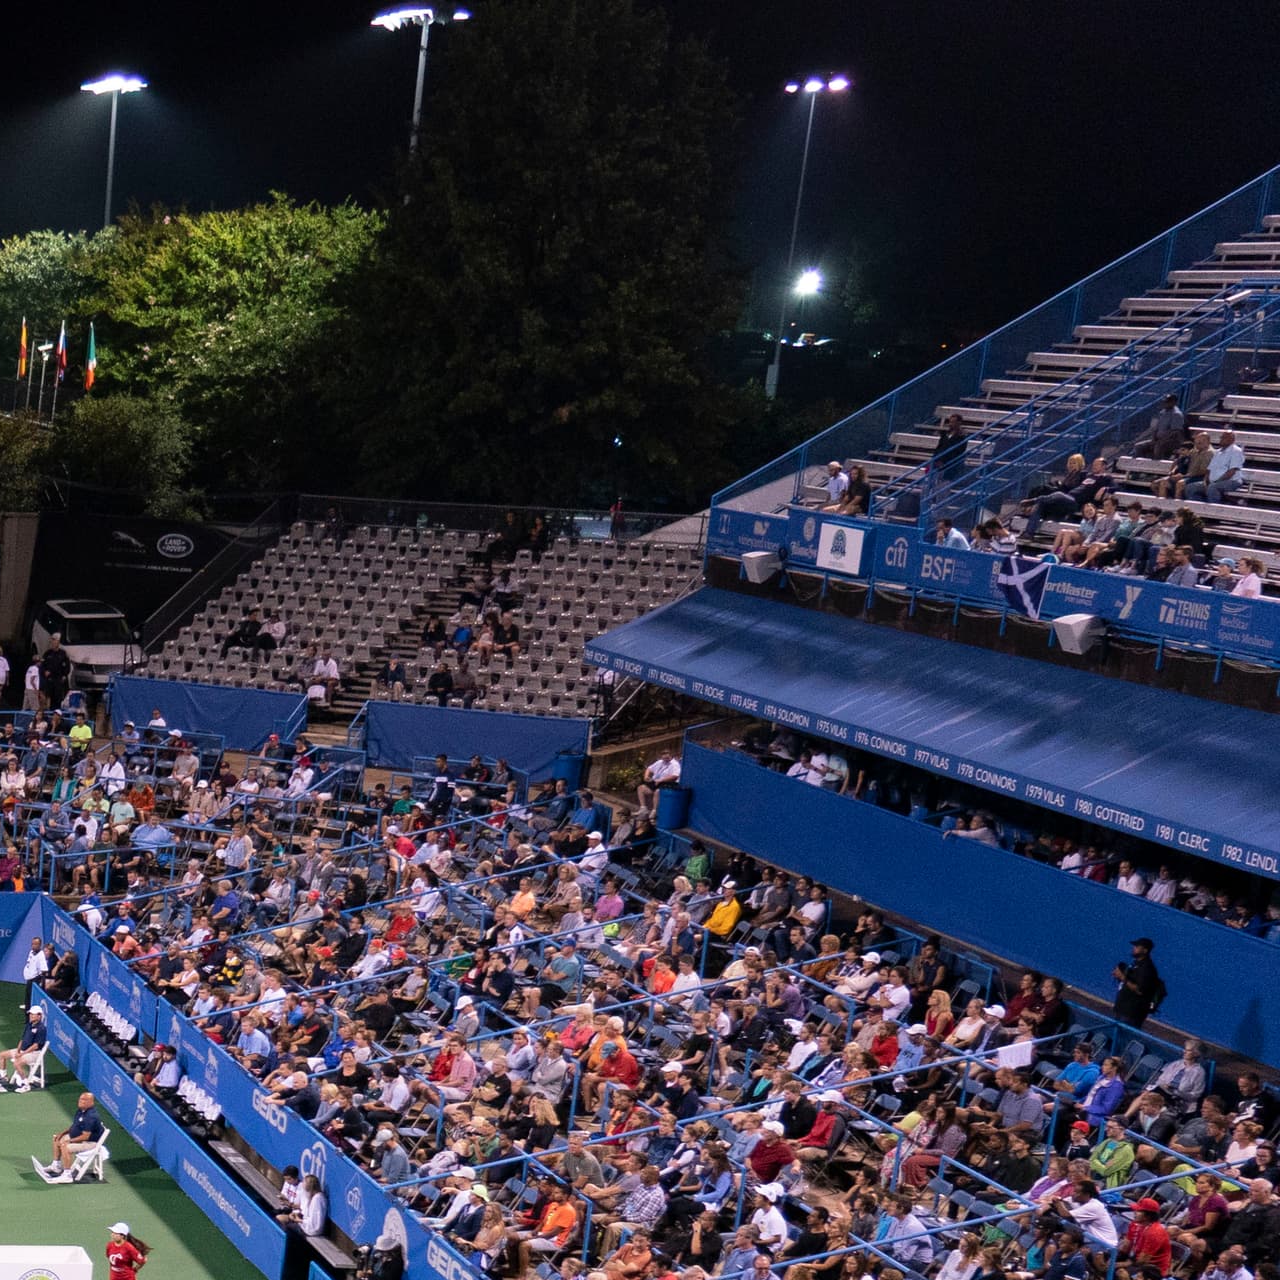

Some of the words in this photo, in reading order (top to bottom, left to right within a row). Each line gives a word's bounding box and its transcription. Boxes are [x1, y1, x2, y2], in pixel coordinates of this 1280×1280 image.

[885, 545, 908, 568] citi
[1046, 581, 1097, 600] ortMaster
[1177, 599, 1211, 621] TENNIS
[692, 681, 704, 694] 1972
[704, 685, 725, 701] ROCHE
[730, 694, 742, 707] 1973
[742, 697, 758, 712] ASHE
[764, 704, 777, 717] 1974
[777, 708, 810, 728] SOLOMON
[816, 719, 830, 733] 1975
[830, 722, 848, 739] VILAS
[854, 731, 869, 745] 1976
[870, 736, 907, 757] CONNORS
[914, 749, 930, 763] 1977
[930, 753, 950, 770] VILAS
[956, 763, 973, 778] 1978
[975, 768, 1017, 792] CONNORS
[1025, 783, 1043, 800] 1979
[1043, 789, 1065, 808] VILAS
[1075, 798, 1093, 815] 1980
[1095, 805, 1145, 832] GOTTFRIED
[1155, 823, 1175, 842] 1981
[1177, 831, 1211, 852] CLERC
[1221, 843, 1243, 862] 1982
[1245, 851, 1279, 874] LENDL
[252, 1088, 288, 1134] GEICO
[300, 1148, 326, 1190] citi
